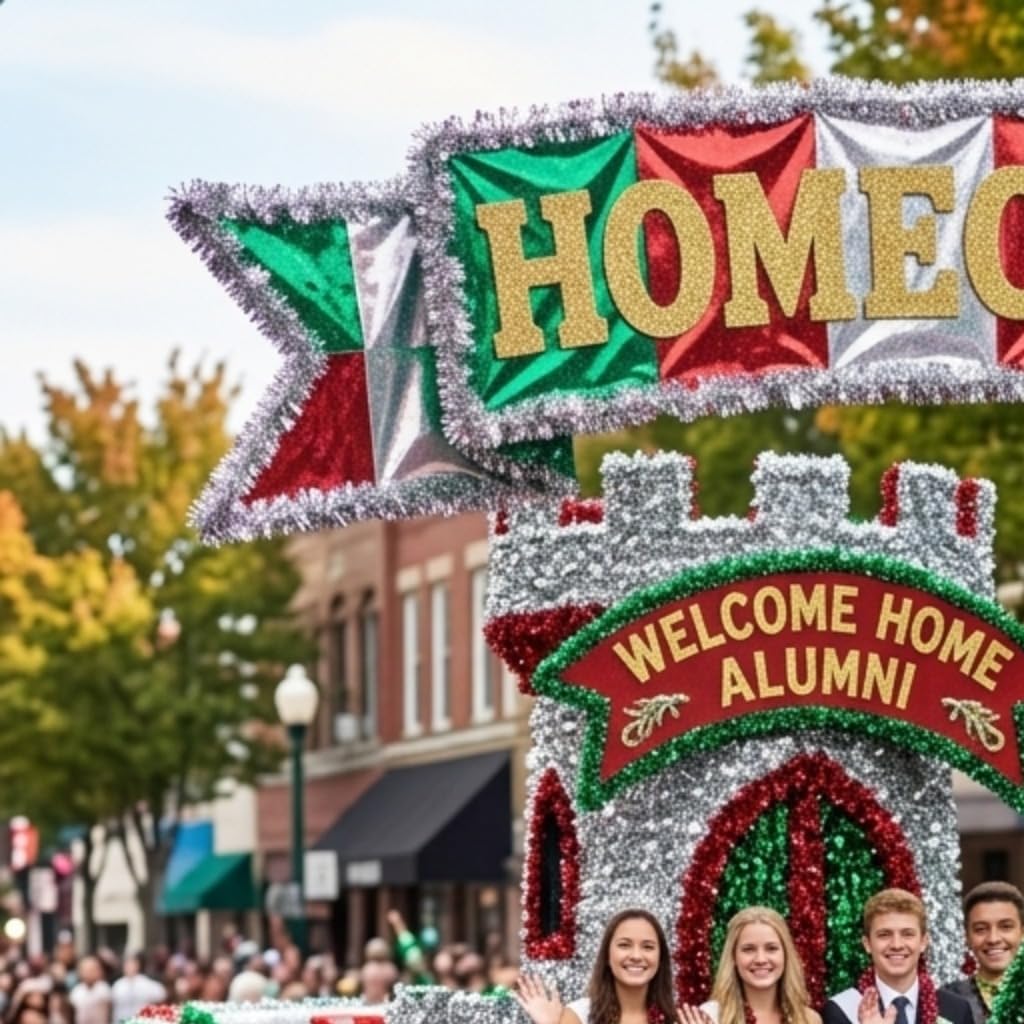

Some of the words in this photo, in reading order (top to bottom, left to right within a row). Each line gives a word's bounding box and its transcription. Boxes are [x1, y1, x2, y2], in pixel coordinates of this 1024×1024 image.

[612, 583, 859, 684] WELCOME
[875, 593, 1014, 691] HOME
[721, 647, 917, 710] ALUMNI
